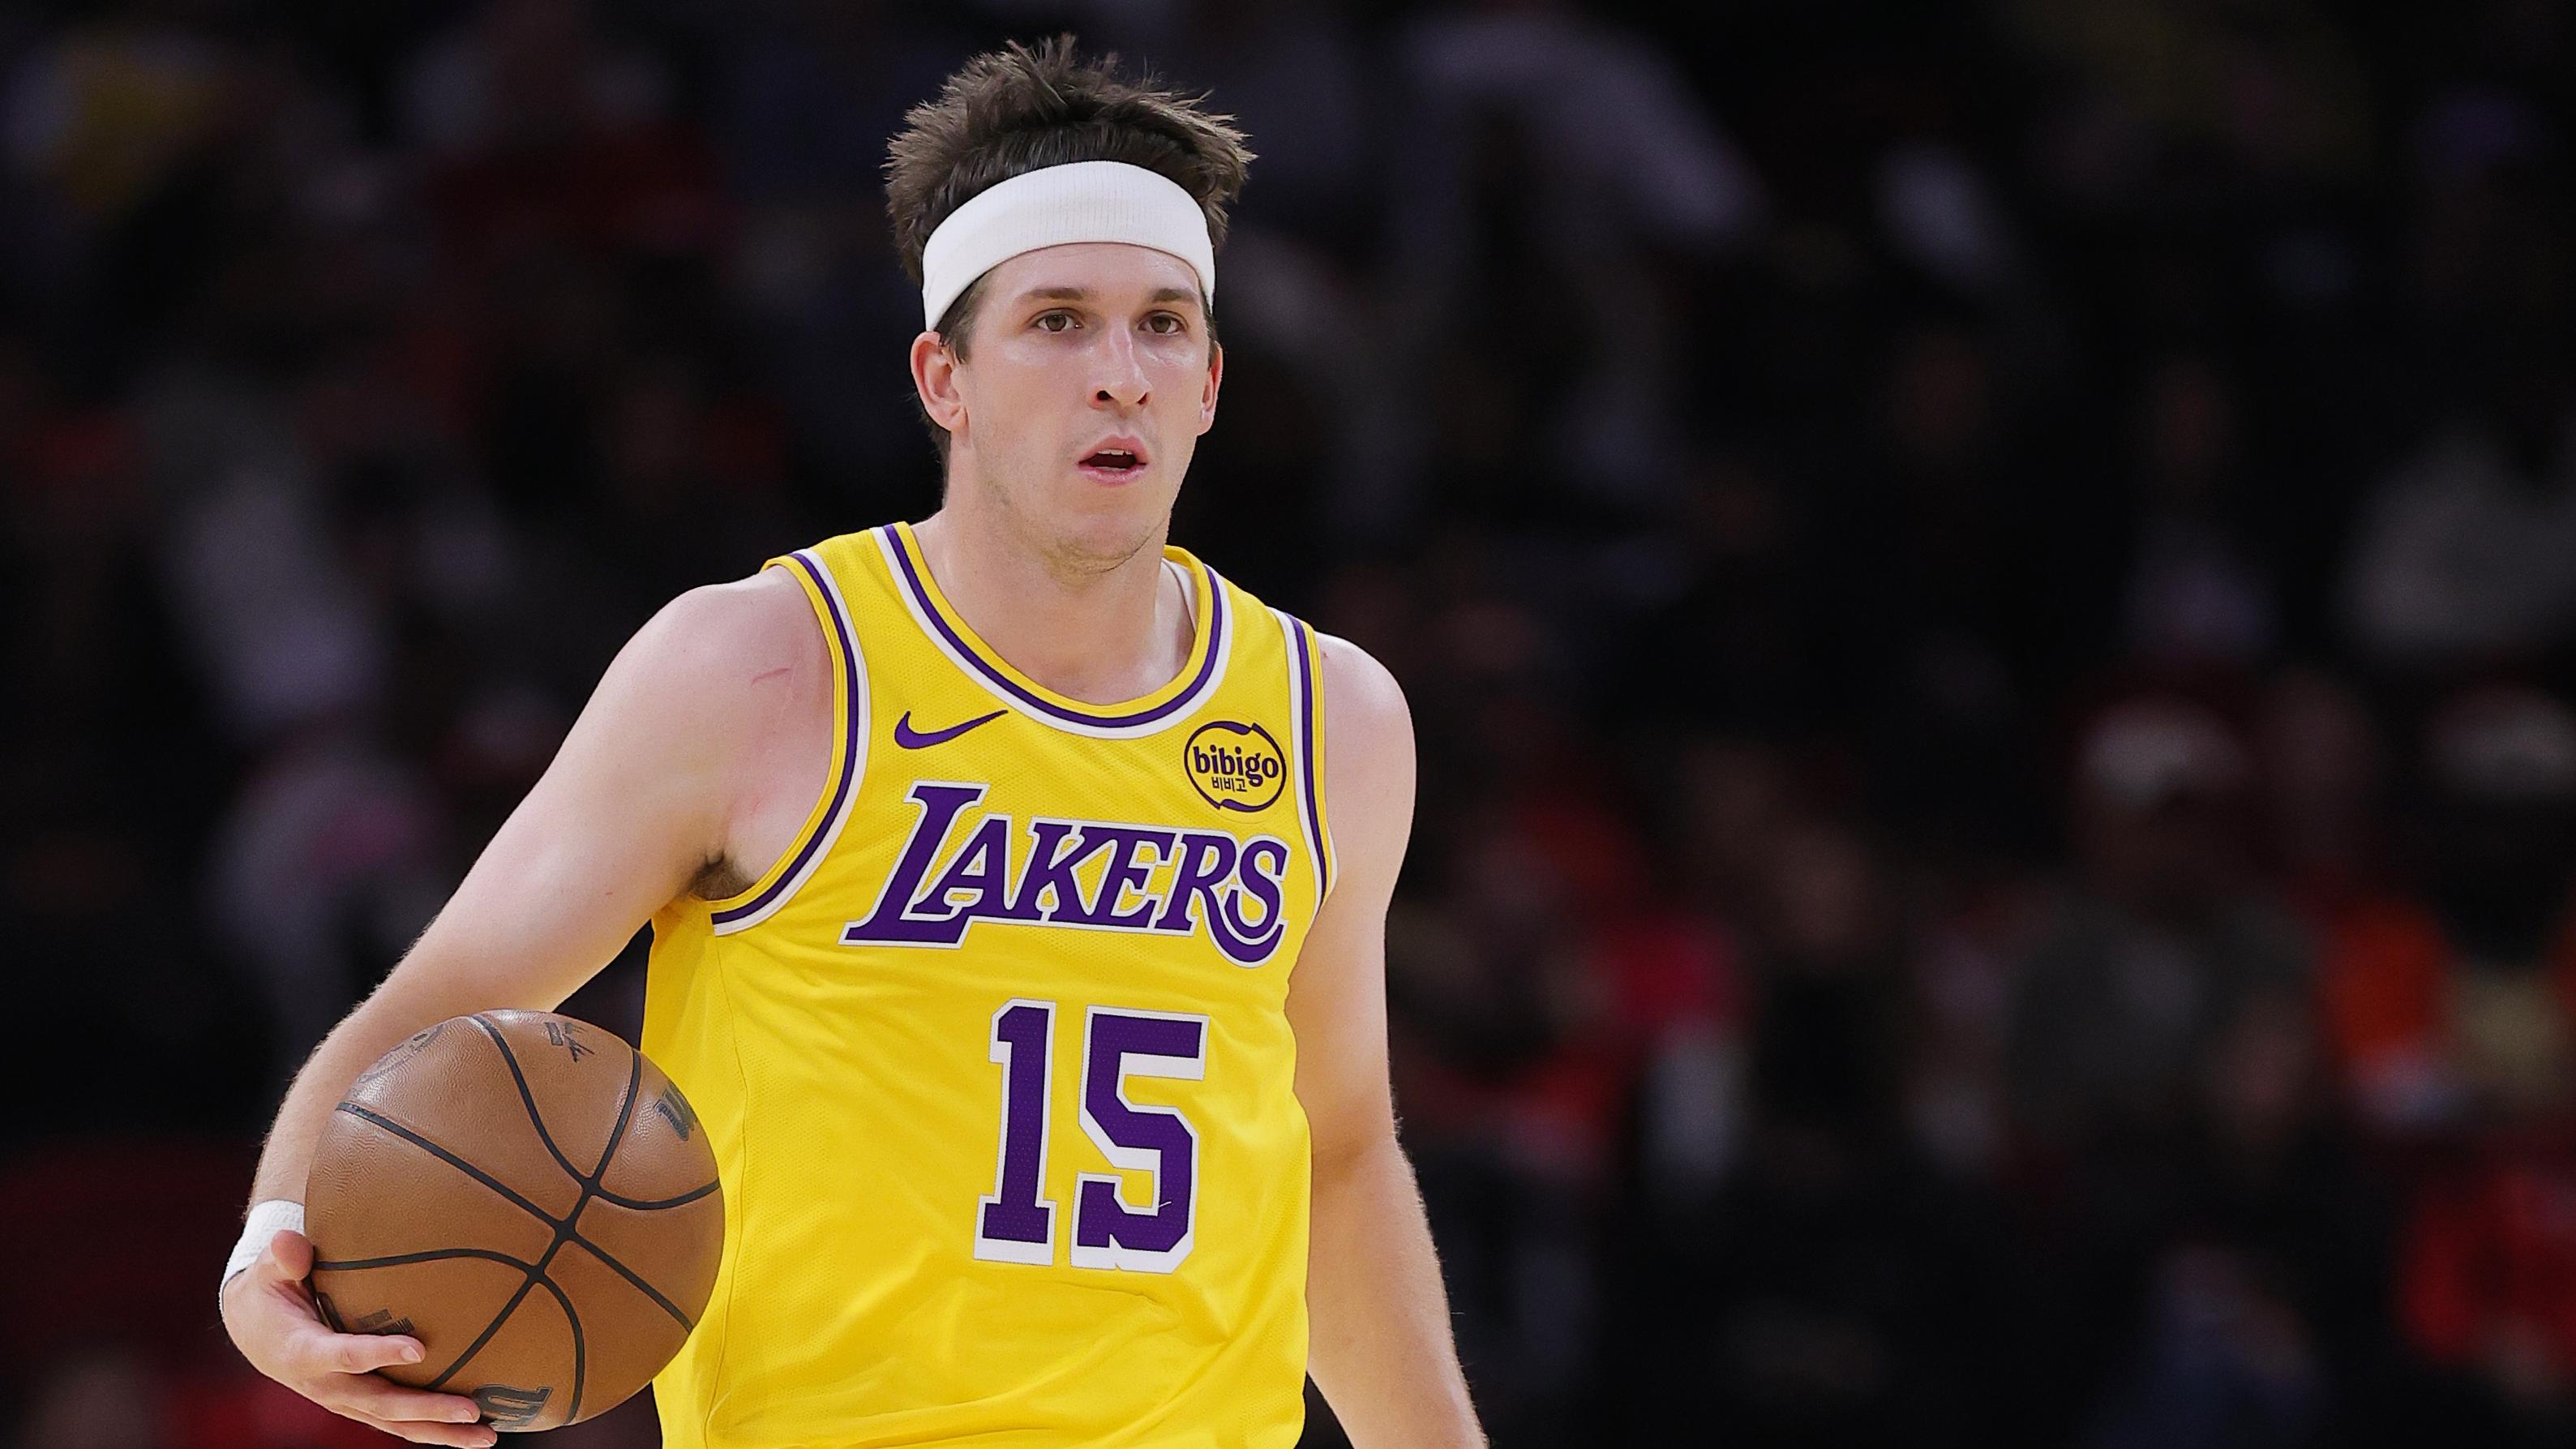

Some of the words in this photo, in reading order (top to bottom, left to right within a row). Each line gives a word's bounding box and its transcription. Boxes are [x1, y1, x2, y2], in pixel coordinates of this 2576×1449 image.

[1193, 744, 1279, 787] bibigo
[1211, 777, 1247, 792] 비비고
[840, 781, 1290, 967] LAKERS
[975, 998, 1209, 1273] 15
